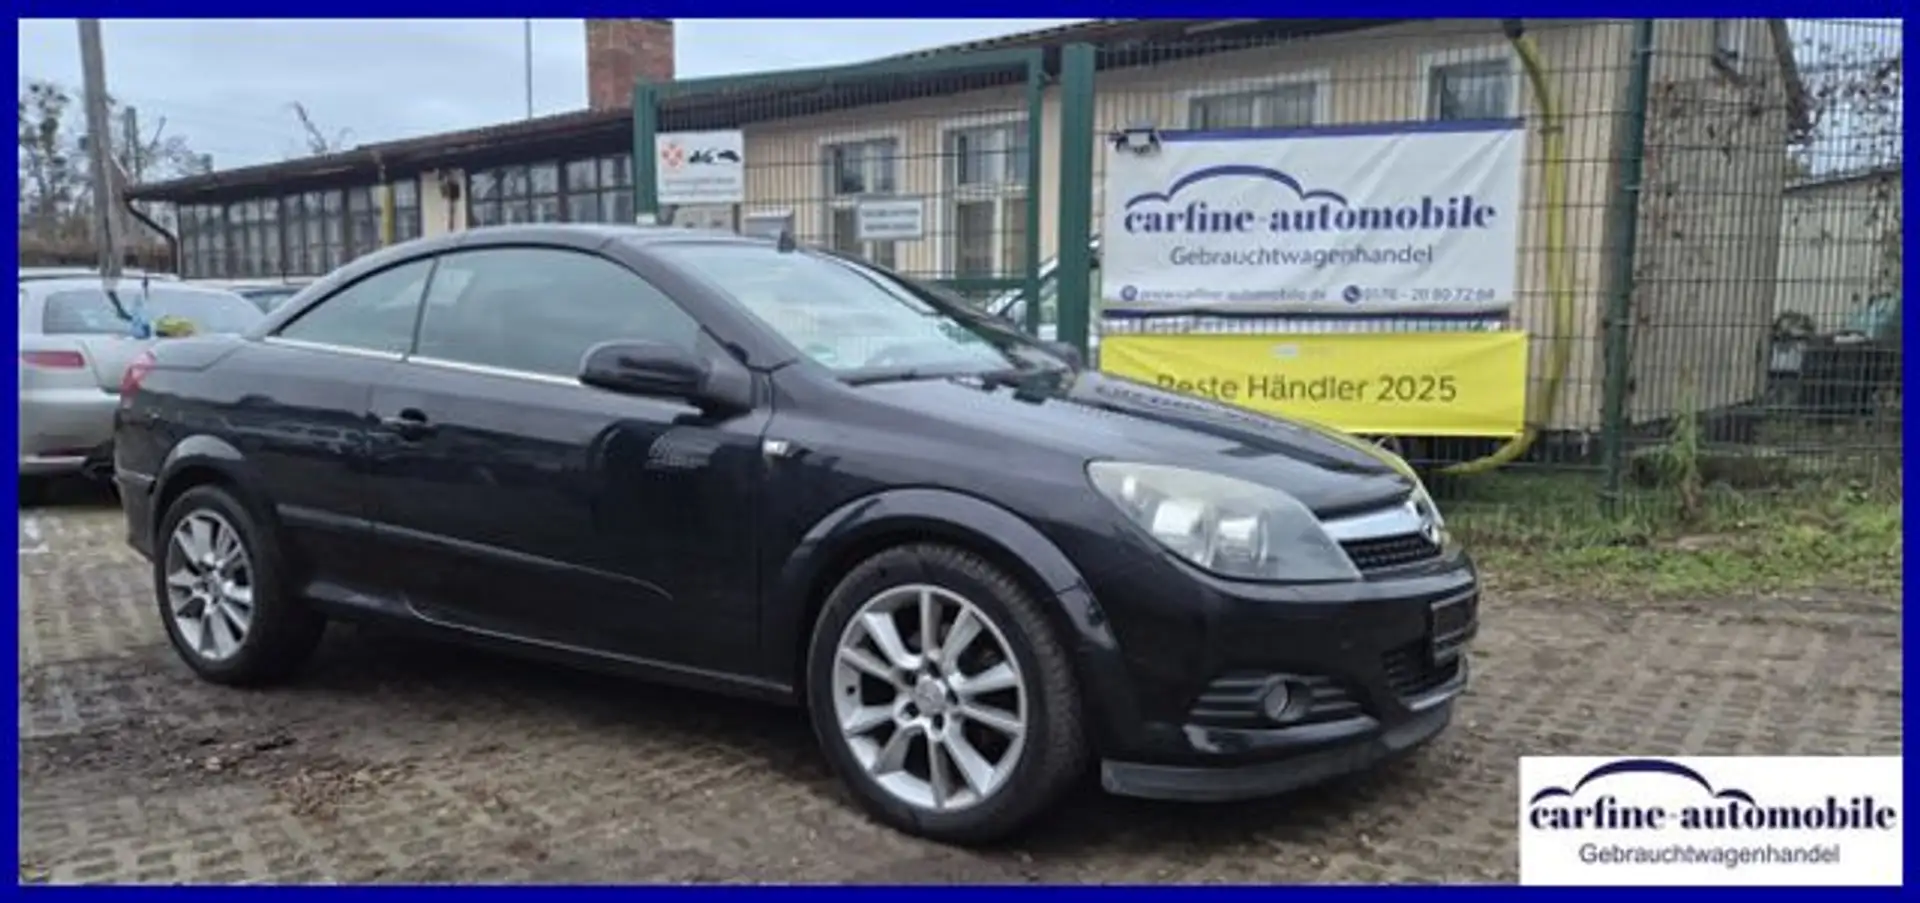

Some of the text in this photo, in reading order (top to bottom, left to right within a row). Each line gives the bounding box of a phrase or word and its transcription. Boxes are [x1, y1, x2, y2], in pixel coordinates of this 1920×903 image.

[1123, 195, 1497, 234] carfine-automobile
[1169, 244, 1433, 269] Gebrauchtwagenhandel
[1248, 373, 1368, 401] Händler
[1377, 374, 1457, 402] 2025
